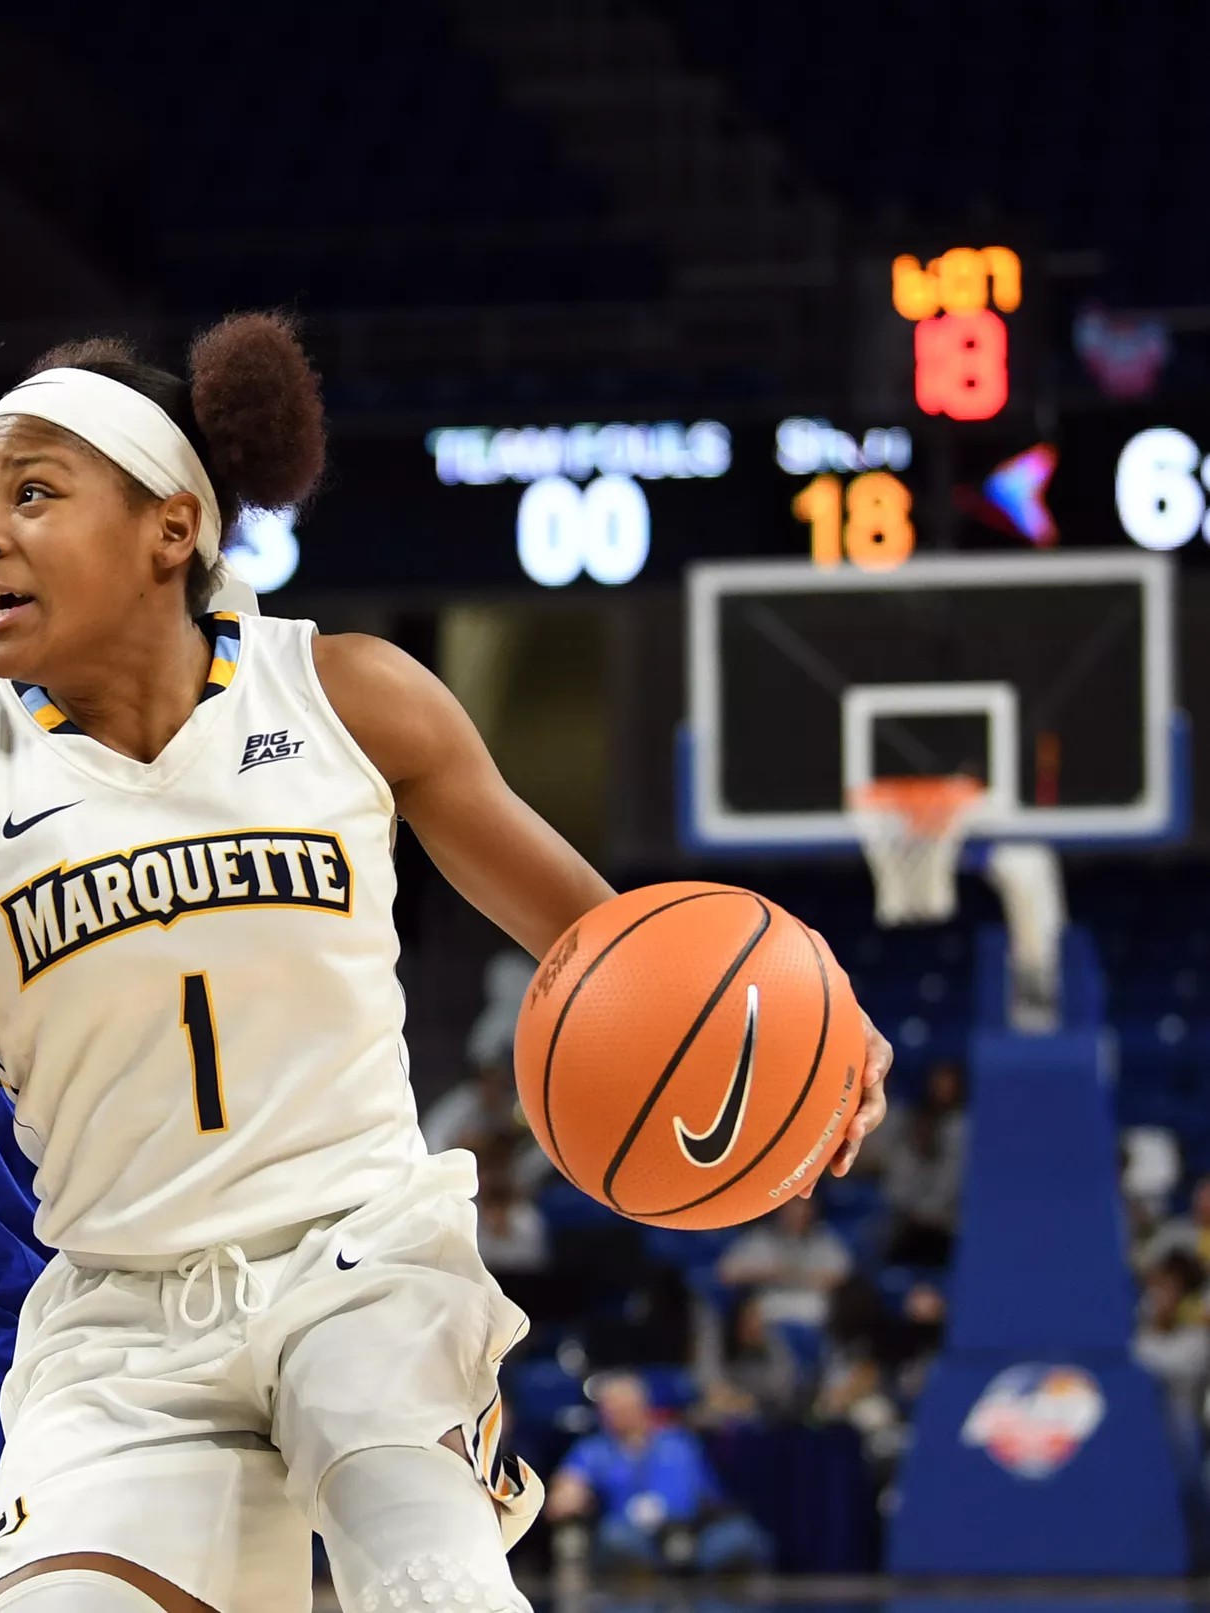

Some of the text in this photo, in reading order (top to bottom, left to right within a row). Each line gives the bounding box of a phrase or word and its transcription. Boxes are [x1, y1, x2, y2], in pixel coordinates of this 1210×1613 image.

[517, 474, 651, 587] 00
[793, 472, 917, 574] 18
[240, 740, 306, 767] EAST
[244, 729, 289, 752] BIG
[12, 836, 349, 970] MARQUETTE
[180, 971, 229, 1134] 1
